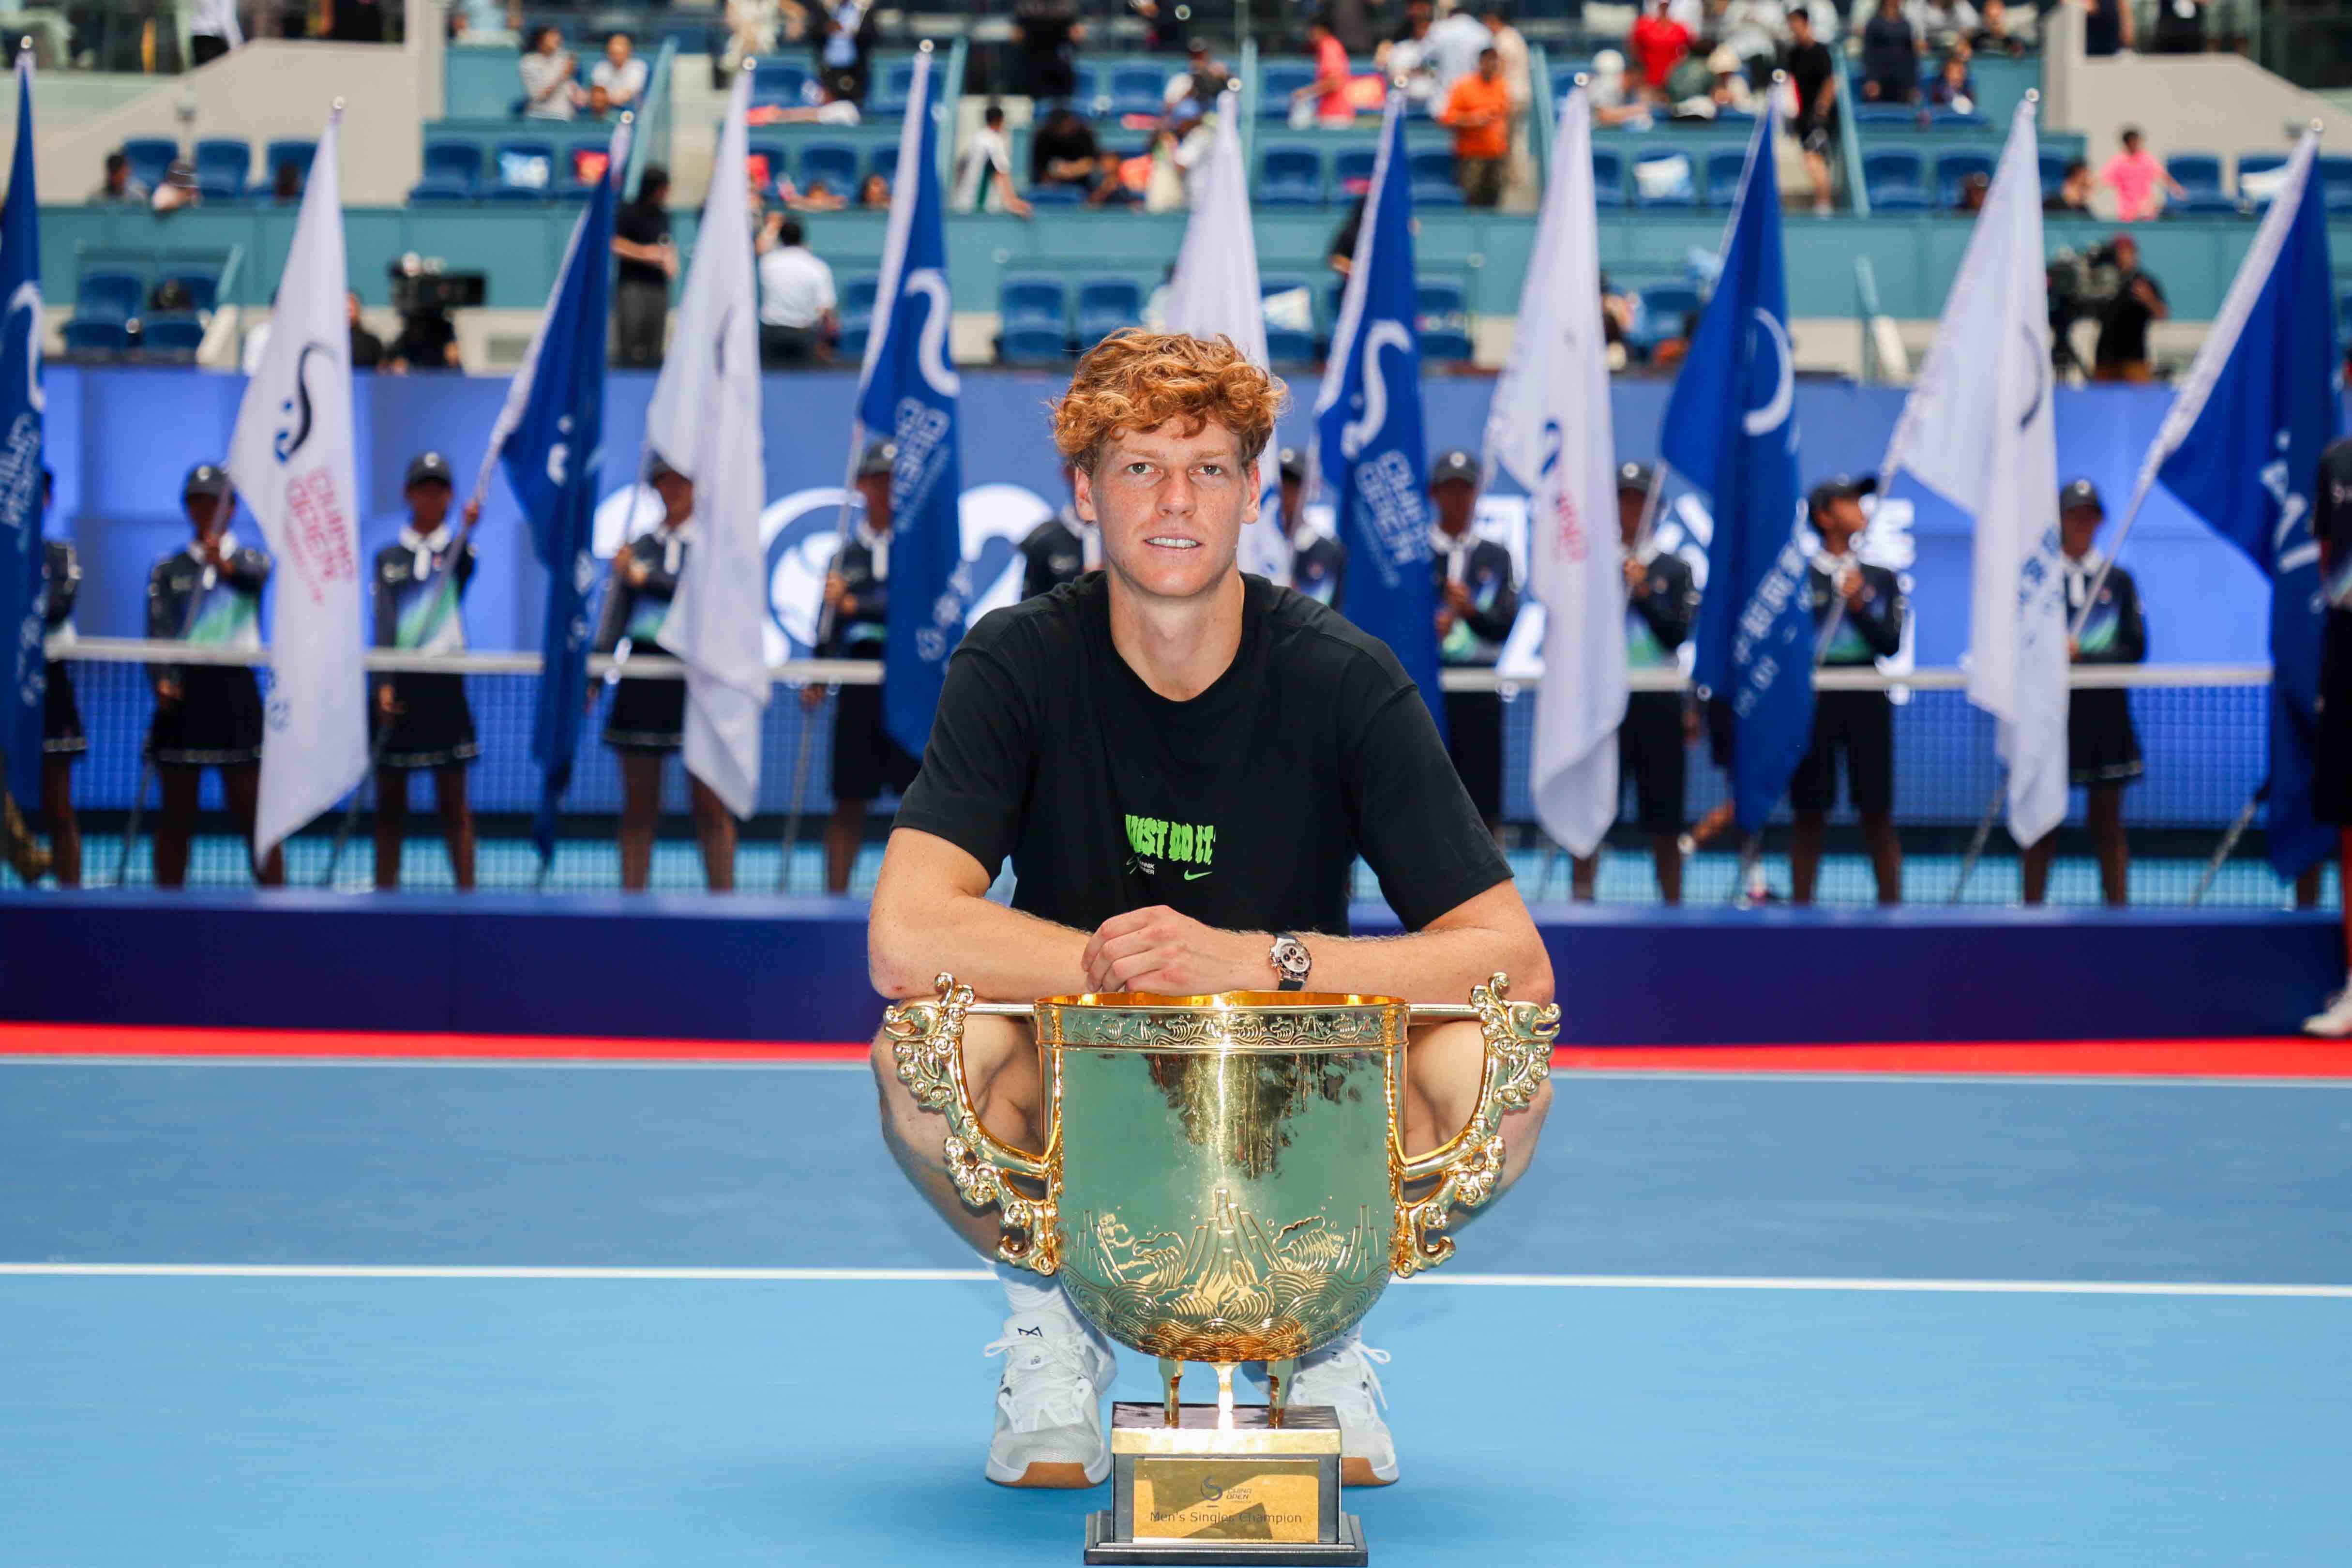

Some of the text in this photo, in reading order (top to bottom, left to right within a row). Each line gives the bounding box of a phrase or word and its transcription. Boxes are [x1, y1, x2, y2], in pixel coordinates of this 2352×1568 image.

[1125, 814, 1169, 859] JUST
[1168, 821, 1193, 862] DO
[1150, 1511, 1302, 1524] Men's Singles Champion
